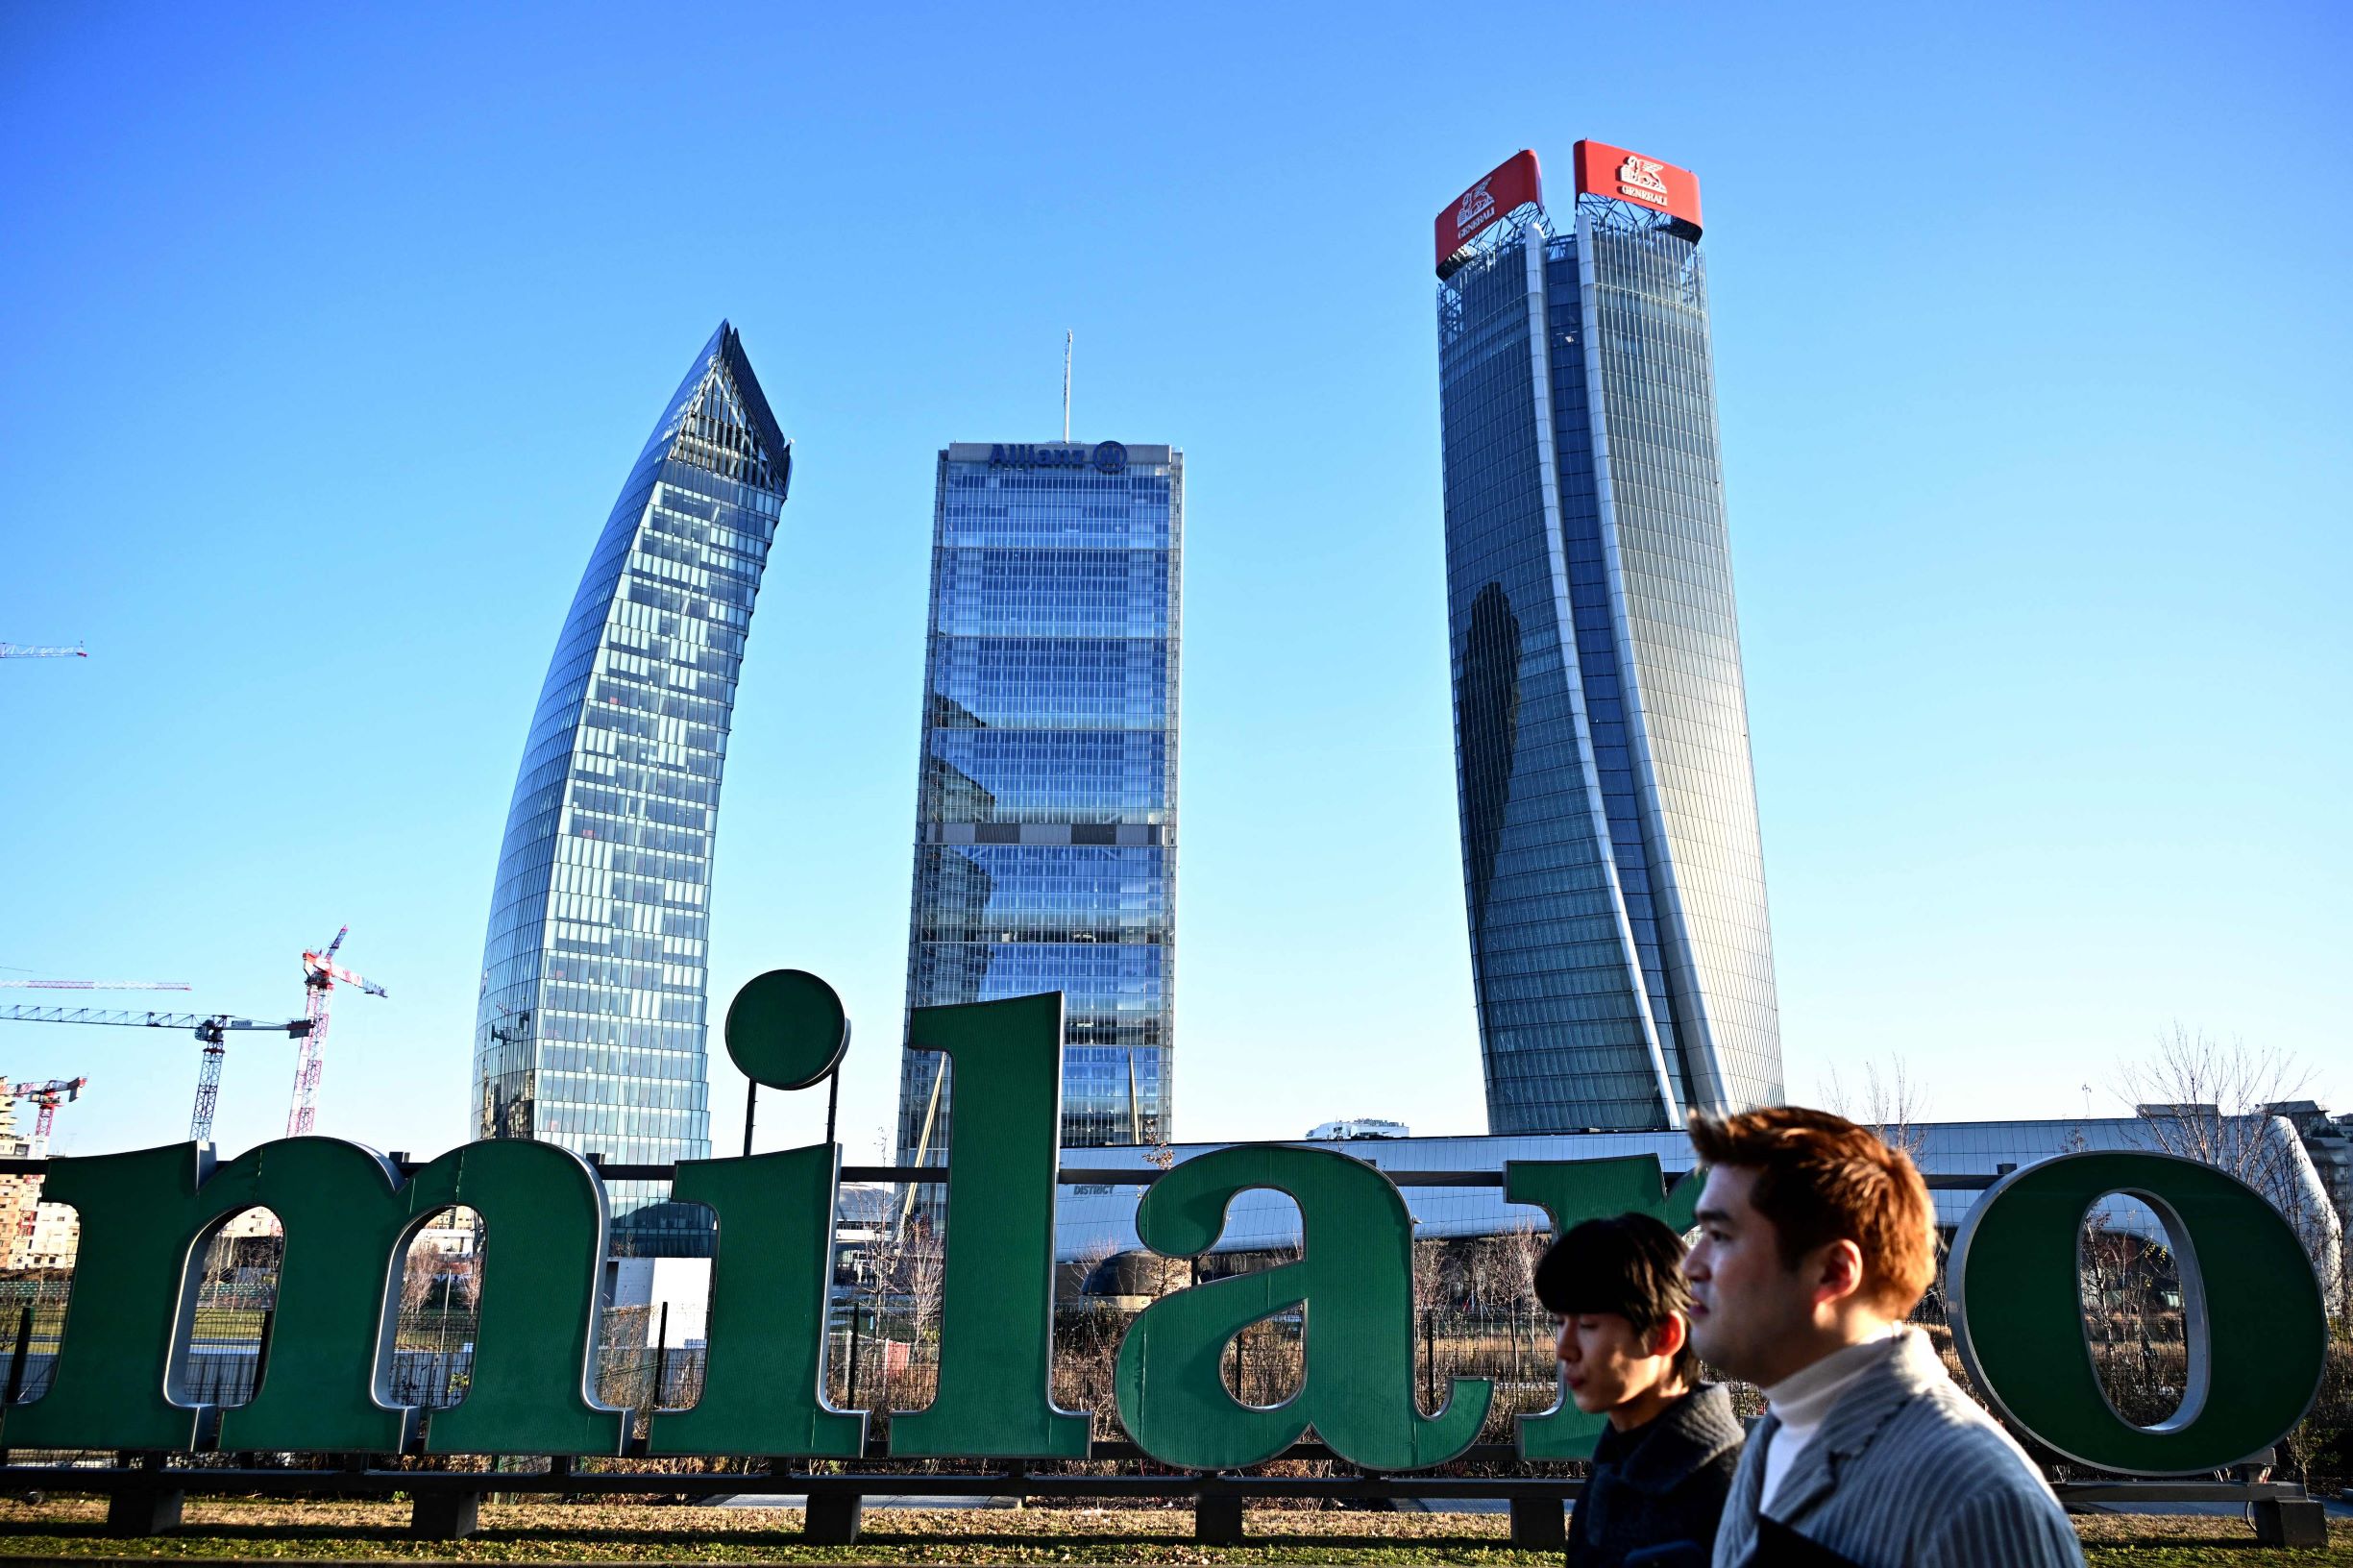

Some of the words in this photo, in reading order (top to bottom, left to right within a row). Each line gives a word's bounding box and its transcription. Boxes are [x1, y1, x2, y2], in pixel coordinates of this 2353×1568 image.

[1622, 184, 1668, 207] GENERALI
[1458, 207, 1495, 239] GENERALI
[990, 444, 1086, 466] Allianz
[1072, 1184, 1115, 1195] DISTRICT
